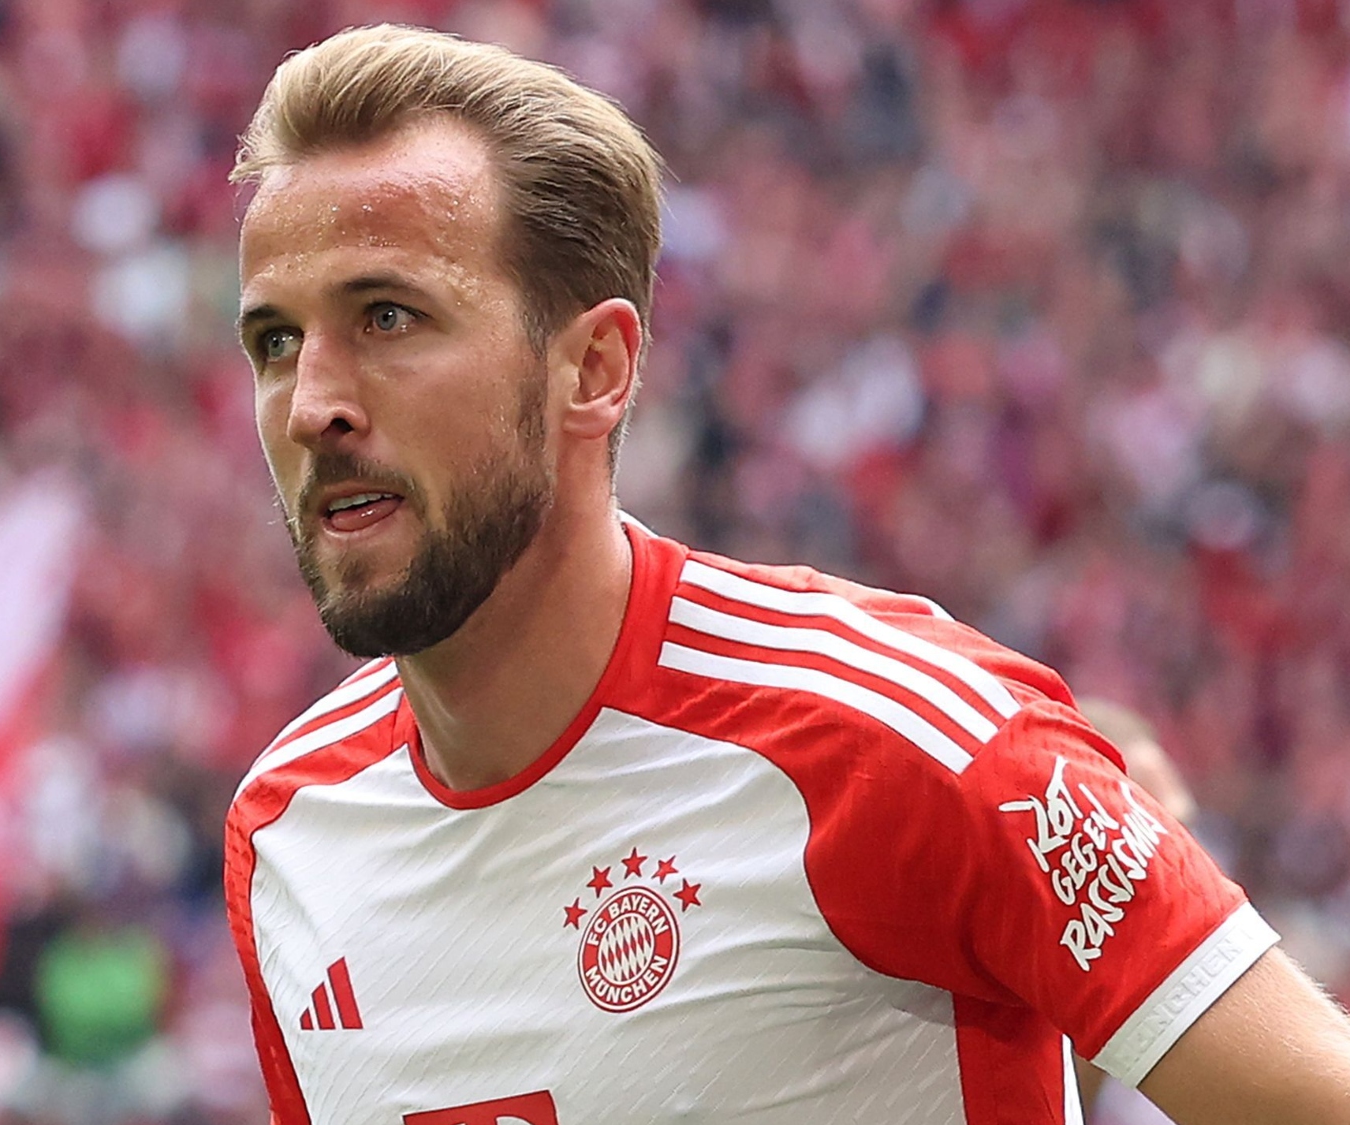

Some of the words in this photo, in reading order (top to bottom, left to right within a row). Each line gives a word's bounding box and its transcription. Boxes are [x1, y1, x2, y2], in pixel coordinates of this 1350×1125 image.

[998, 755, 1083, 872] ROT
[1052, 783, 1119, 905] GEGEN
[586, 919, 608, 947] FC
[608, 894, 669, 935] BAYERN
[1059, 780, 1169, 972] RASSISMUS
[585, 955, 669, 1004] MÜNCHEN
